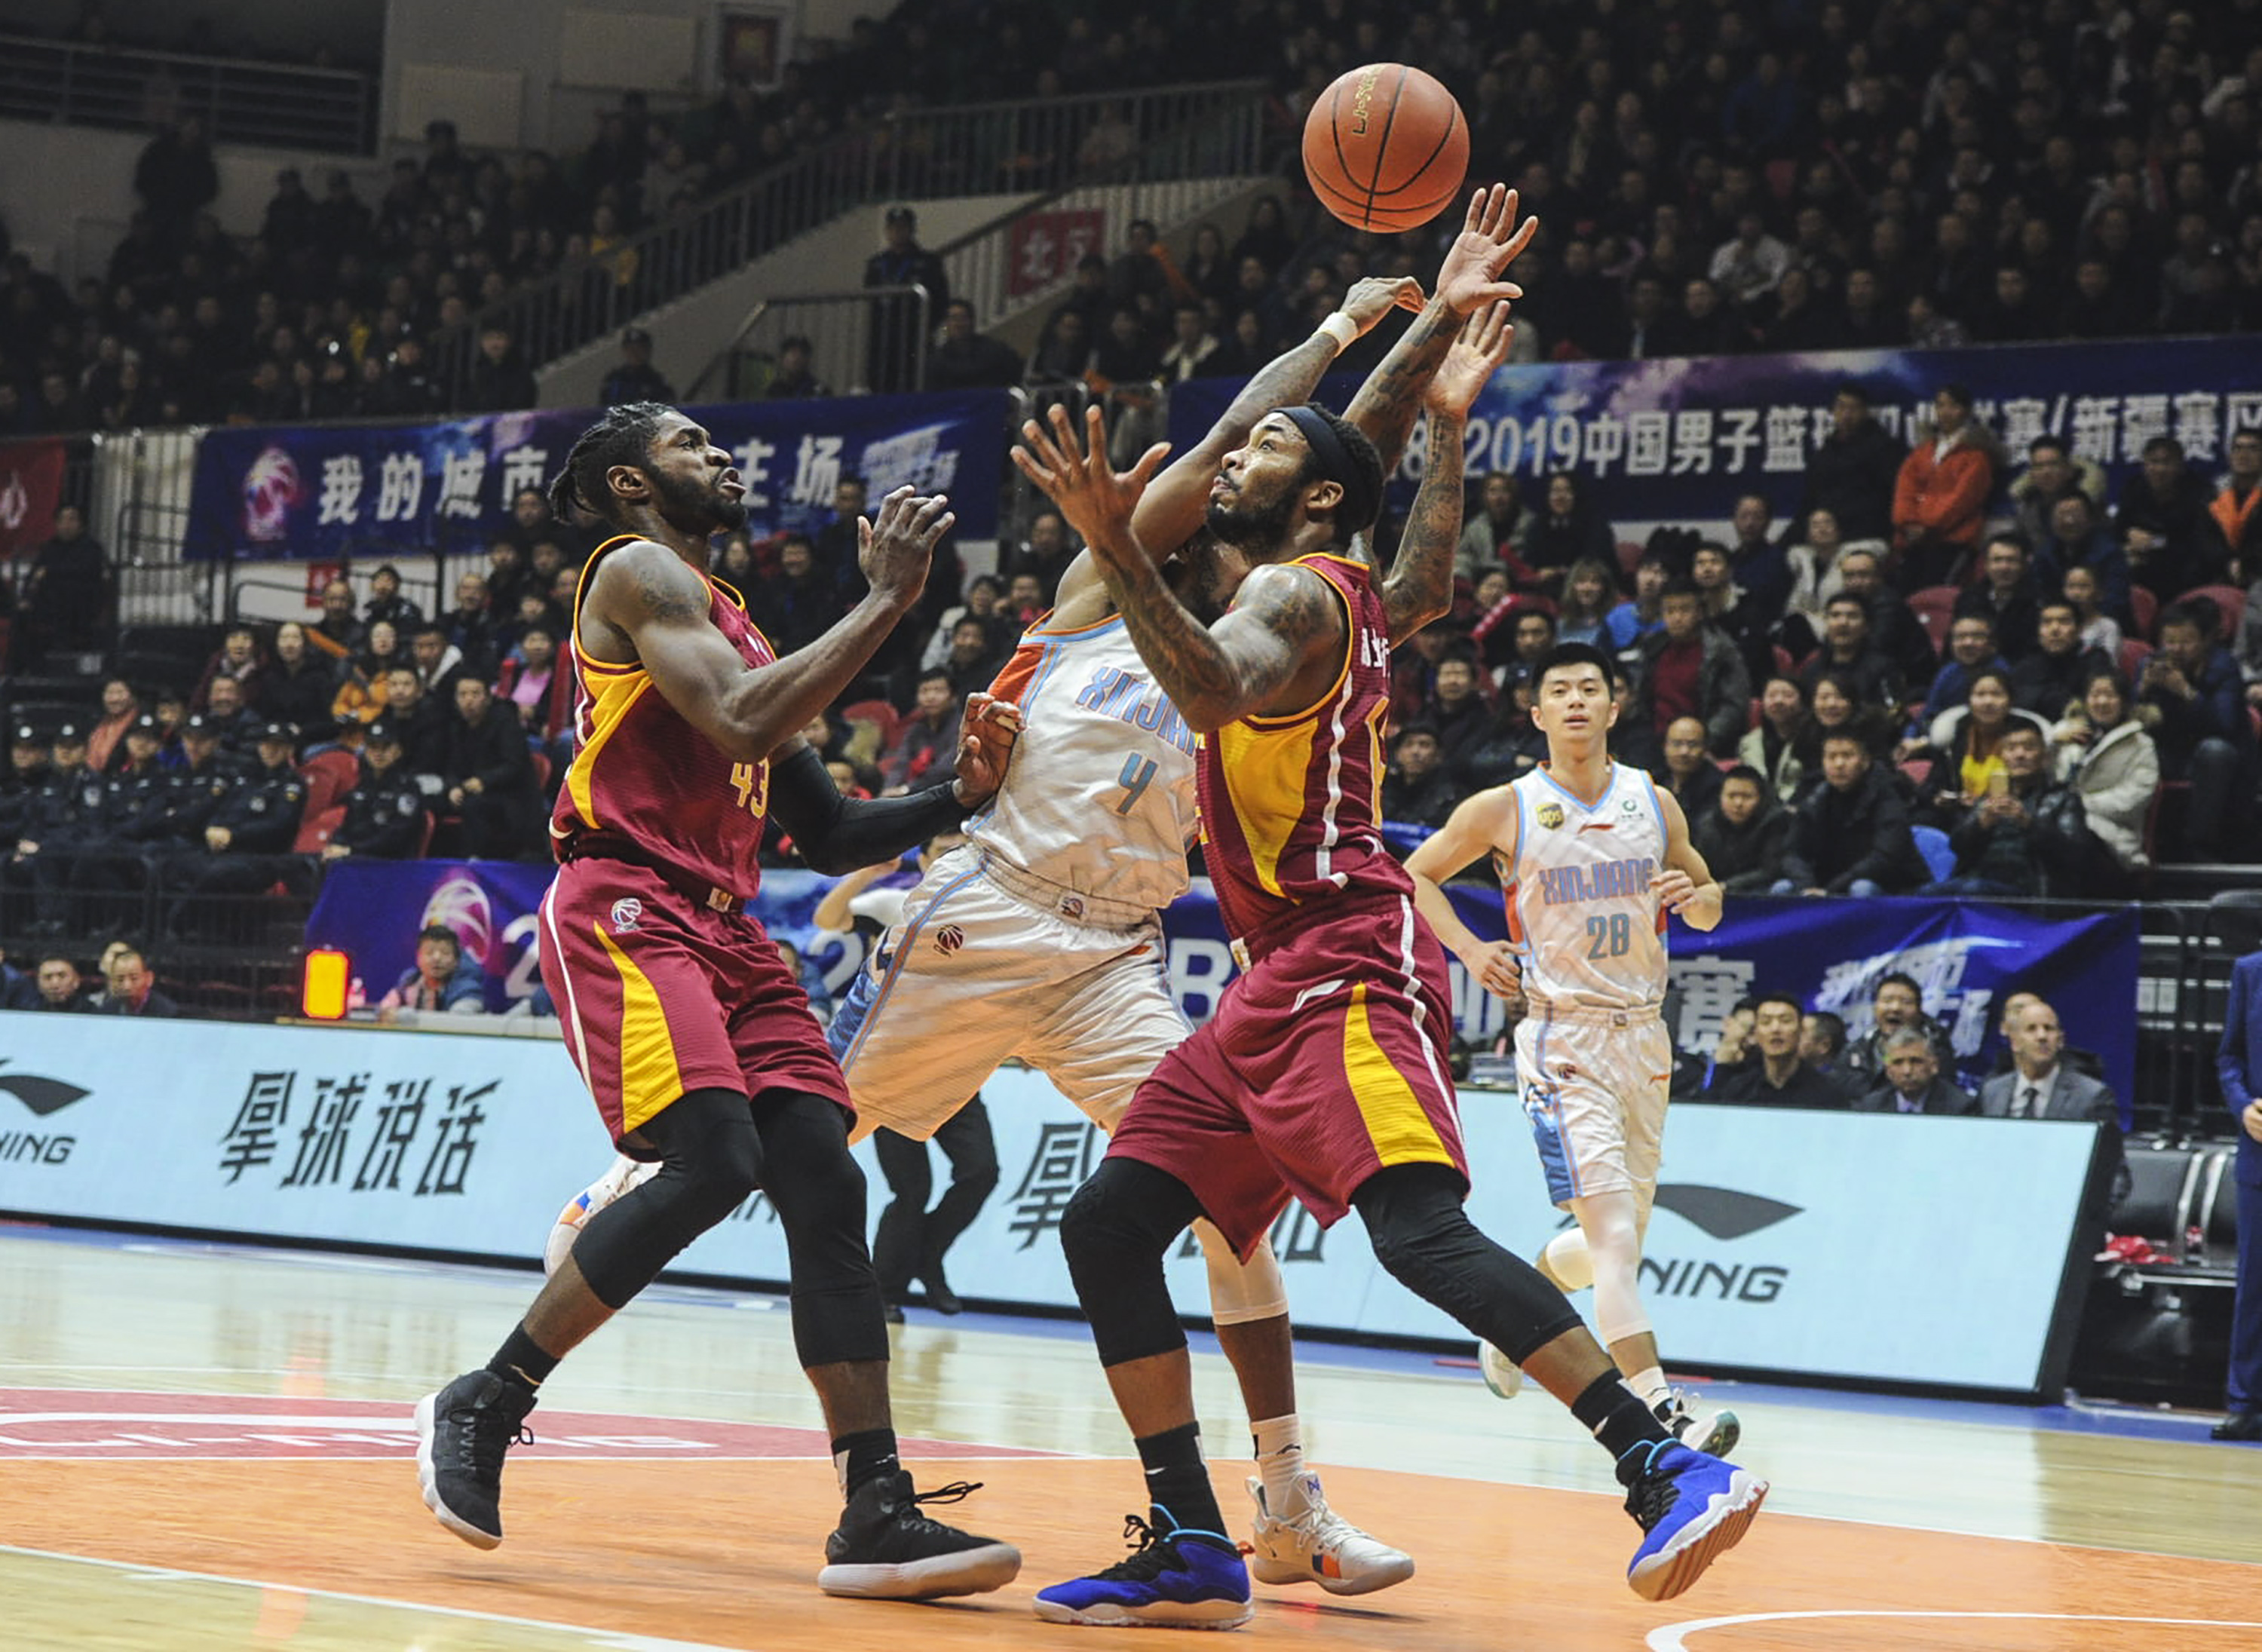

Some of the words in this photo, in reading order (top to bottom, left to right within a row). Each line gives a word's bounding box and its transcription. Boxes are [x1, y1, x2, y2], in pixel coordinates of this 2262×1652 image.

[729, 756, 770, 819] 43
[1116, 752, 1159, 814] 4
[1587, 913, 1629, 960] 28
